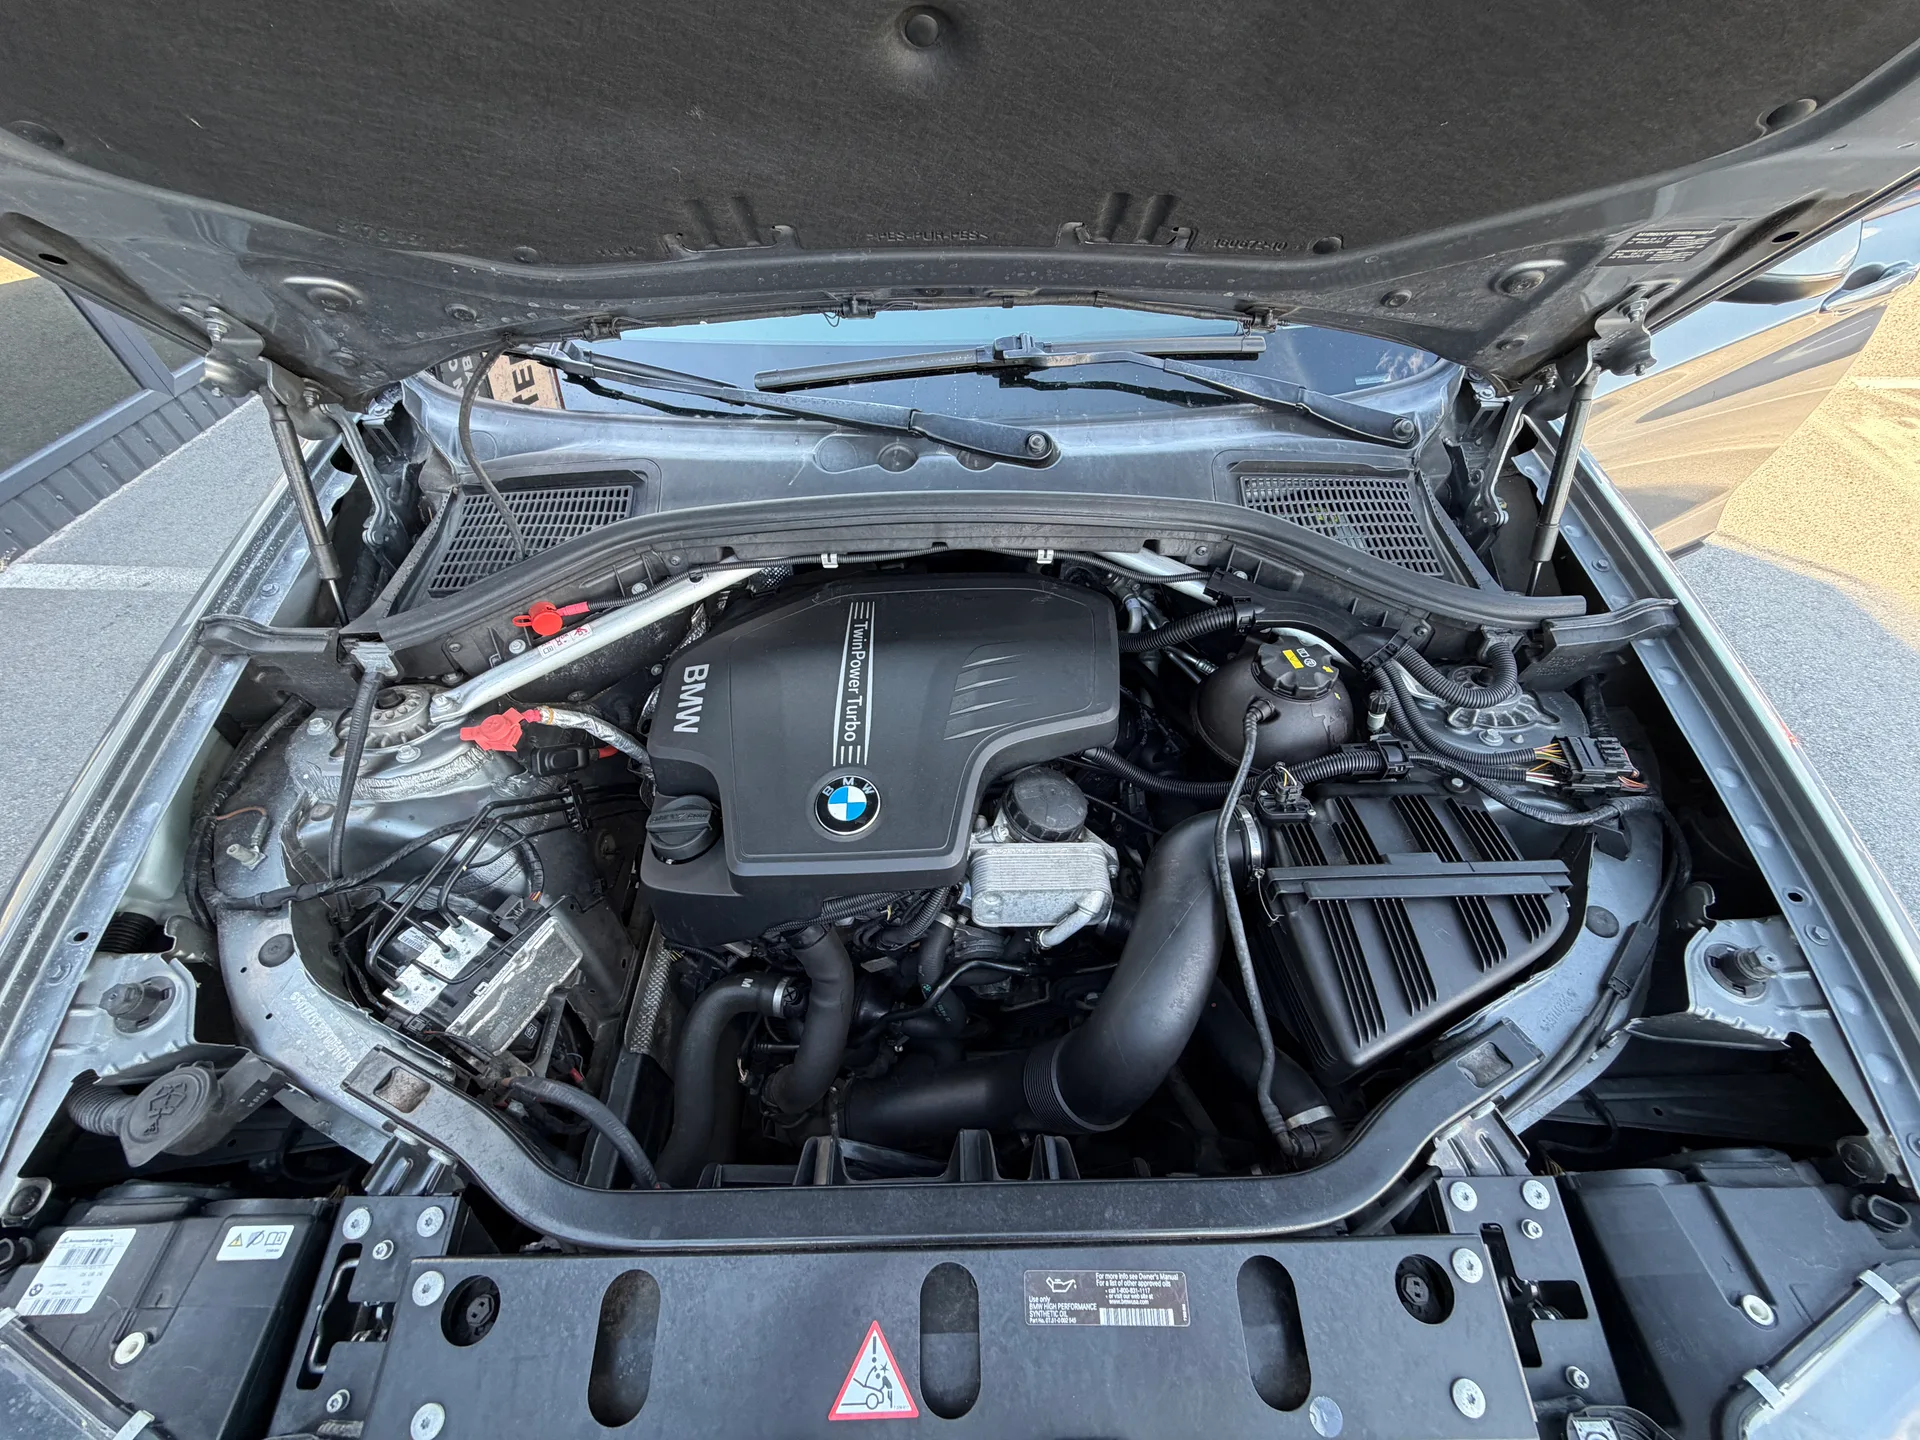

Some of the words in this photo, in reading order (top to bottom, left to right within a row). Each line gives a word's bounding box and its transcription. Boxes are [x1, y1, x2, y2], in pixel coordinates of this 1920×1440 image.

[848, 621, 868, 694] TwinPower
[673, 663, 710, 733] BMW
[844, 695, 863, 742] Turbo
[822, 777, 875, 797] BMW
[1040, 1296, 1051, 1304] only
[1137, 1280, 1161, 1288] approved
